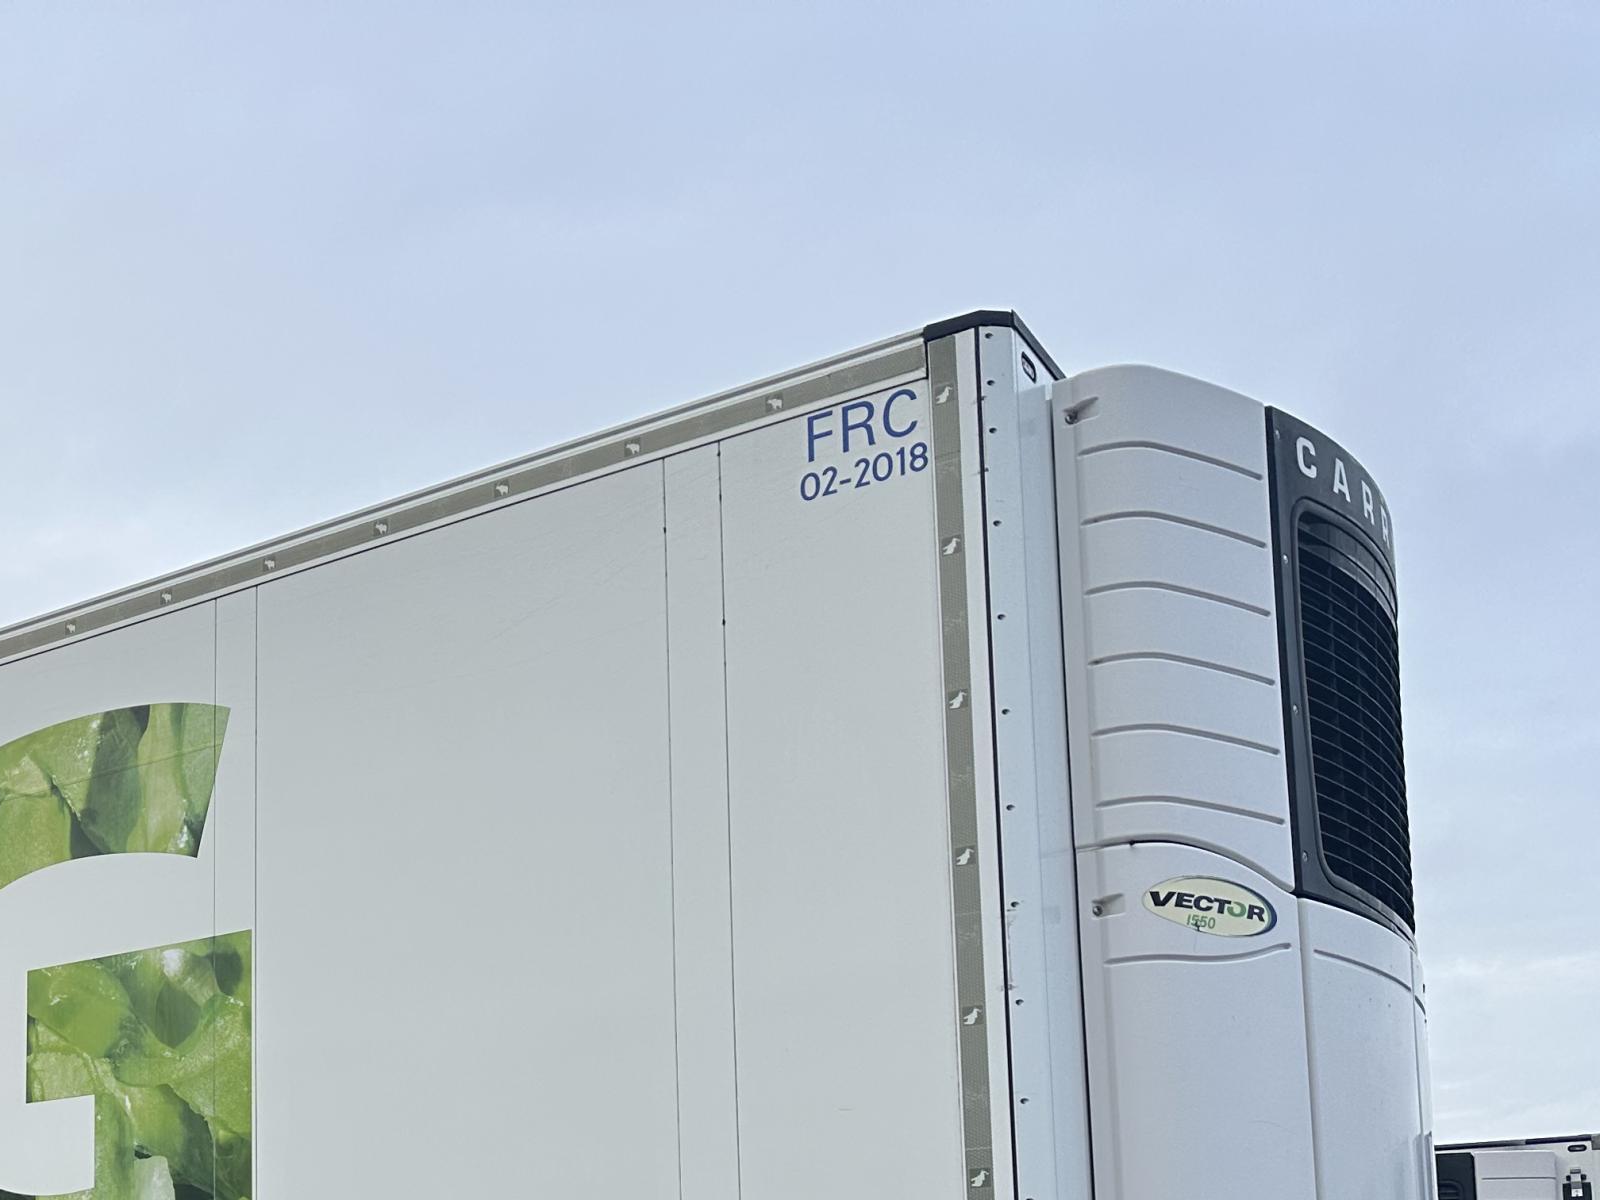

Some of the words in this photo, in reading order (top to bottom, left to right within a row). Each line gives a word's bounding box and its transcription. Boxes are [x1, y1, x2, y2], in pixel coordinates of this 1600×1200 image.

[807, 388, 918, 463] FRC
[799, 441, 929, 501] 02-2018
[1149, 890, 1266, 922] VECTOR
